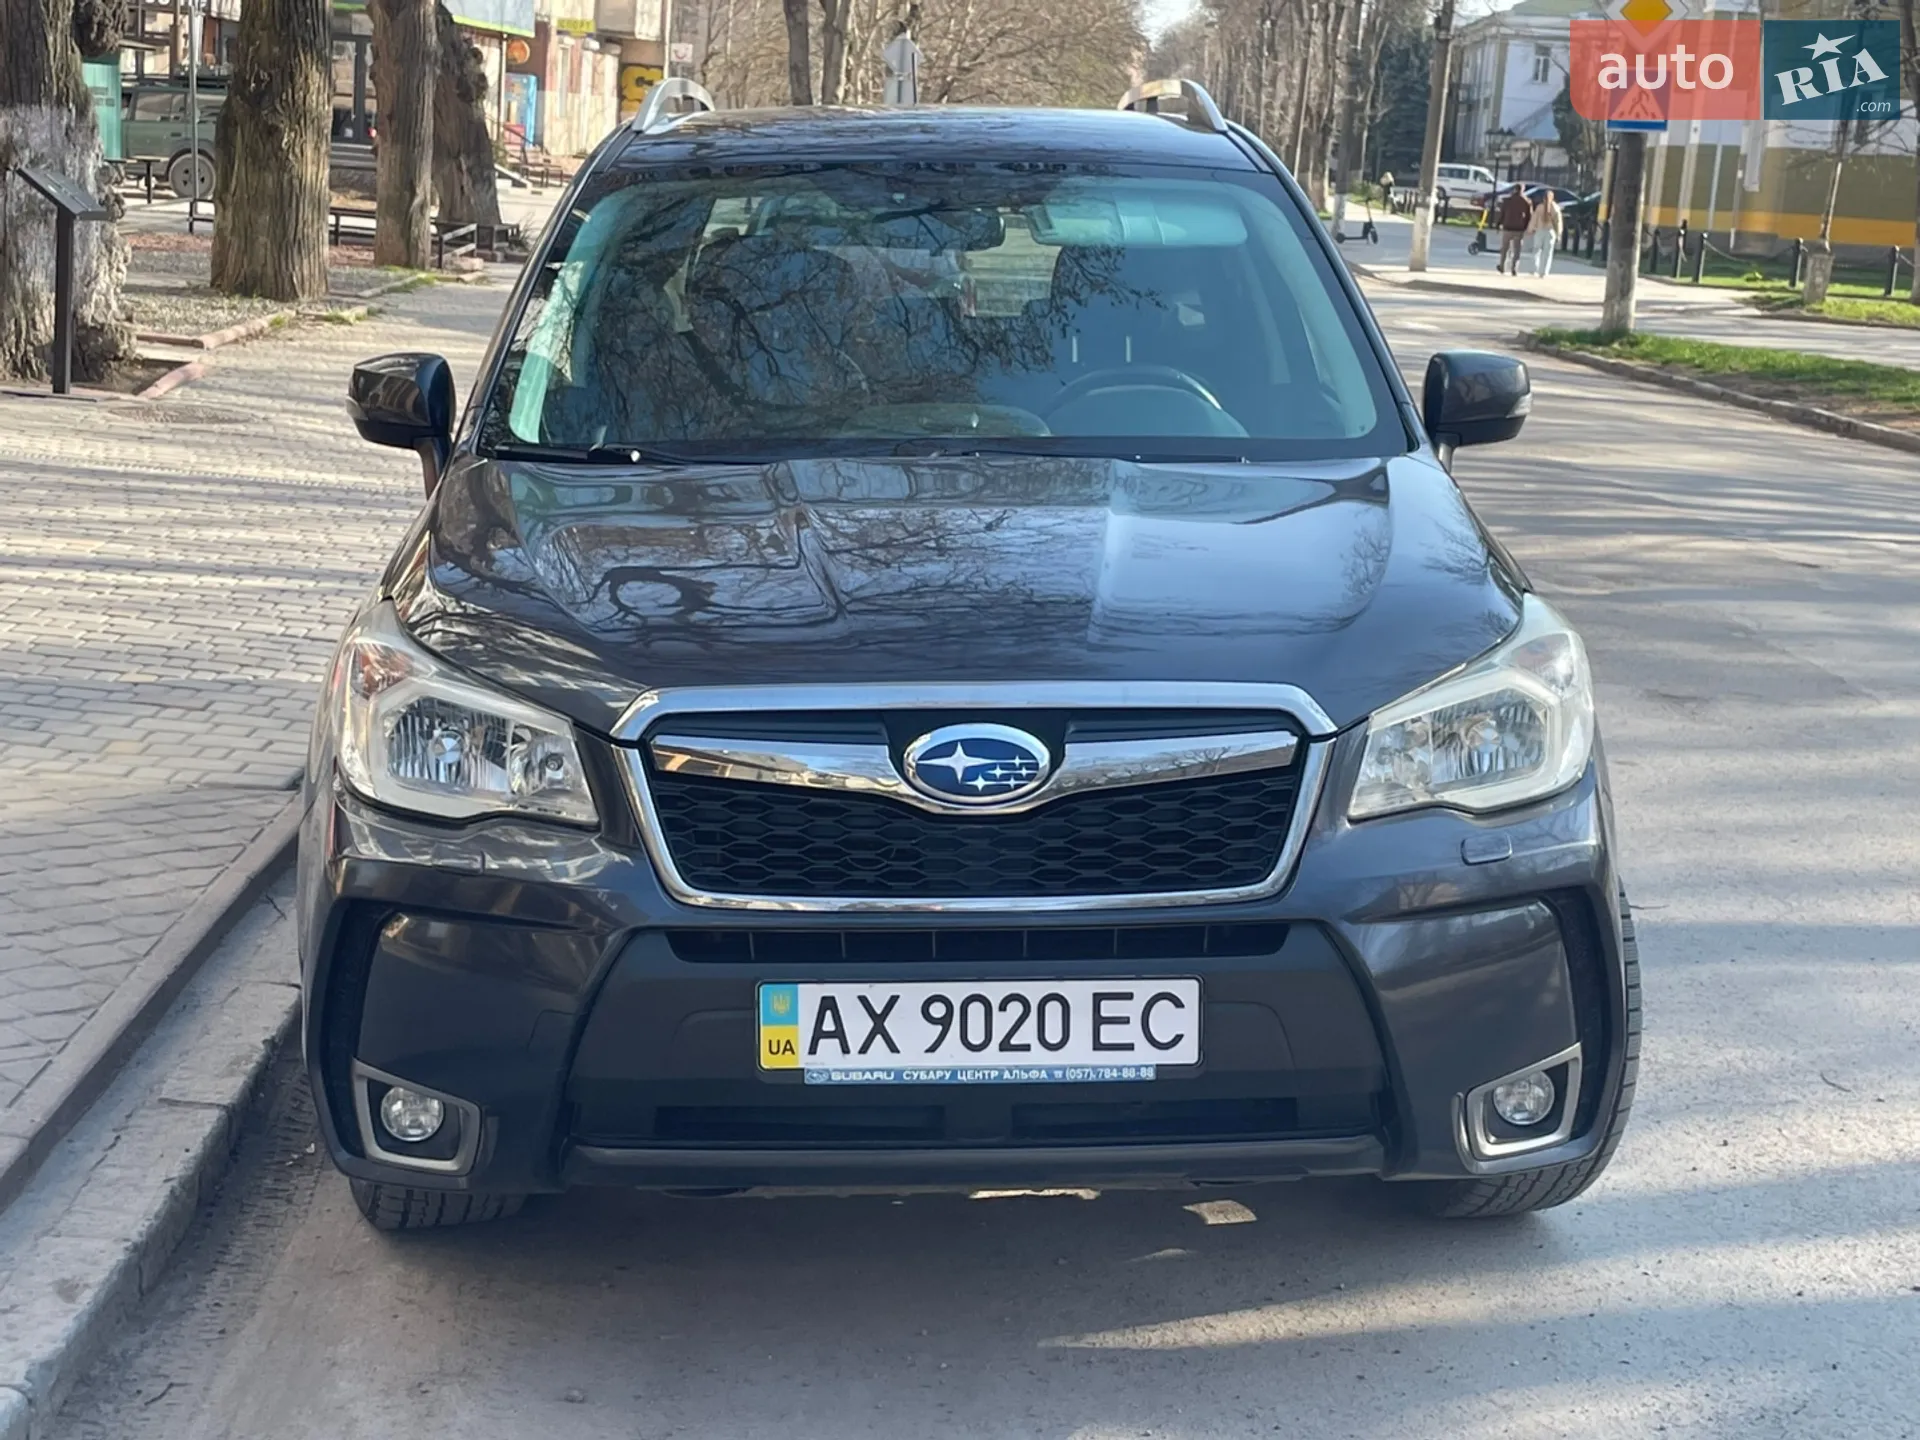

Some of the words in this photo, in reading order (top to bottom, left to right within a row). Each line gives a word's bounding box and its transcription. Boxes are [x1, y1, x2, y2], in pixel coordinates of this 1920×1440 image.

[808, 995, 900, 1055] AX
[921, 993, 1070, 1054] 9020
[1092, 992, 1185, 1052] EC
[768, 1039, 796, 1055] UA
[831, 1071, 895, 1081] SUBARU
[903, 1070, 951, 1081] СУБАРУ
[957, 1070, 998, 1082] ЦЕНТР
[1003, 1069, 1048, 1080] АЛЬФА
